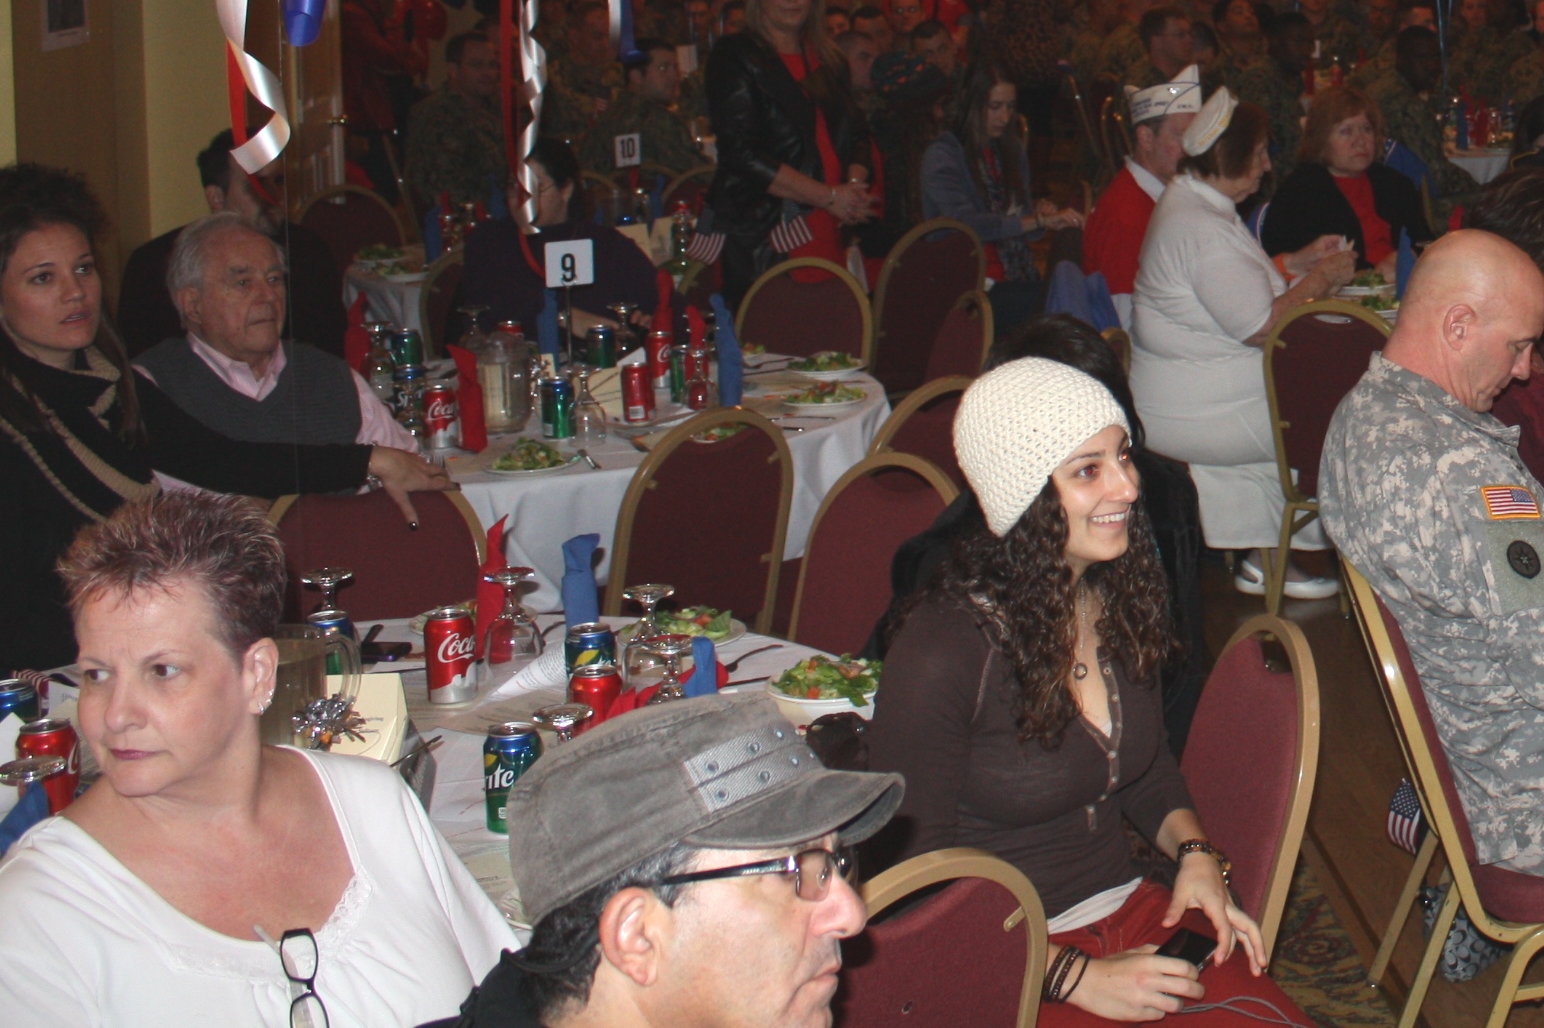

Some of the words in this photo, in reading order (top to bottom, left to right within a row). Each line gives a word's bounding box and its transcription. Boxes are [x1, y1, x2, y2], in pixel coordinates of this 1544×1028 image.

[620, 138, 634, 158] 10
[561, 253, 575, 282] 9
[437, 632, 475, 664] Coca
